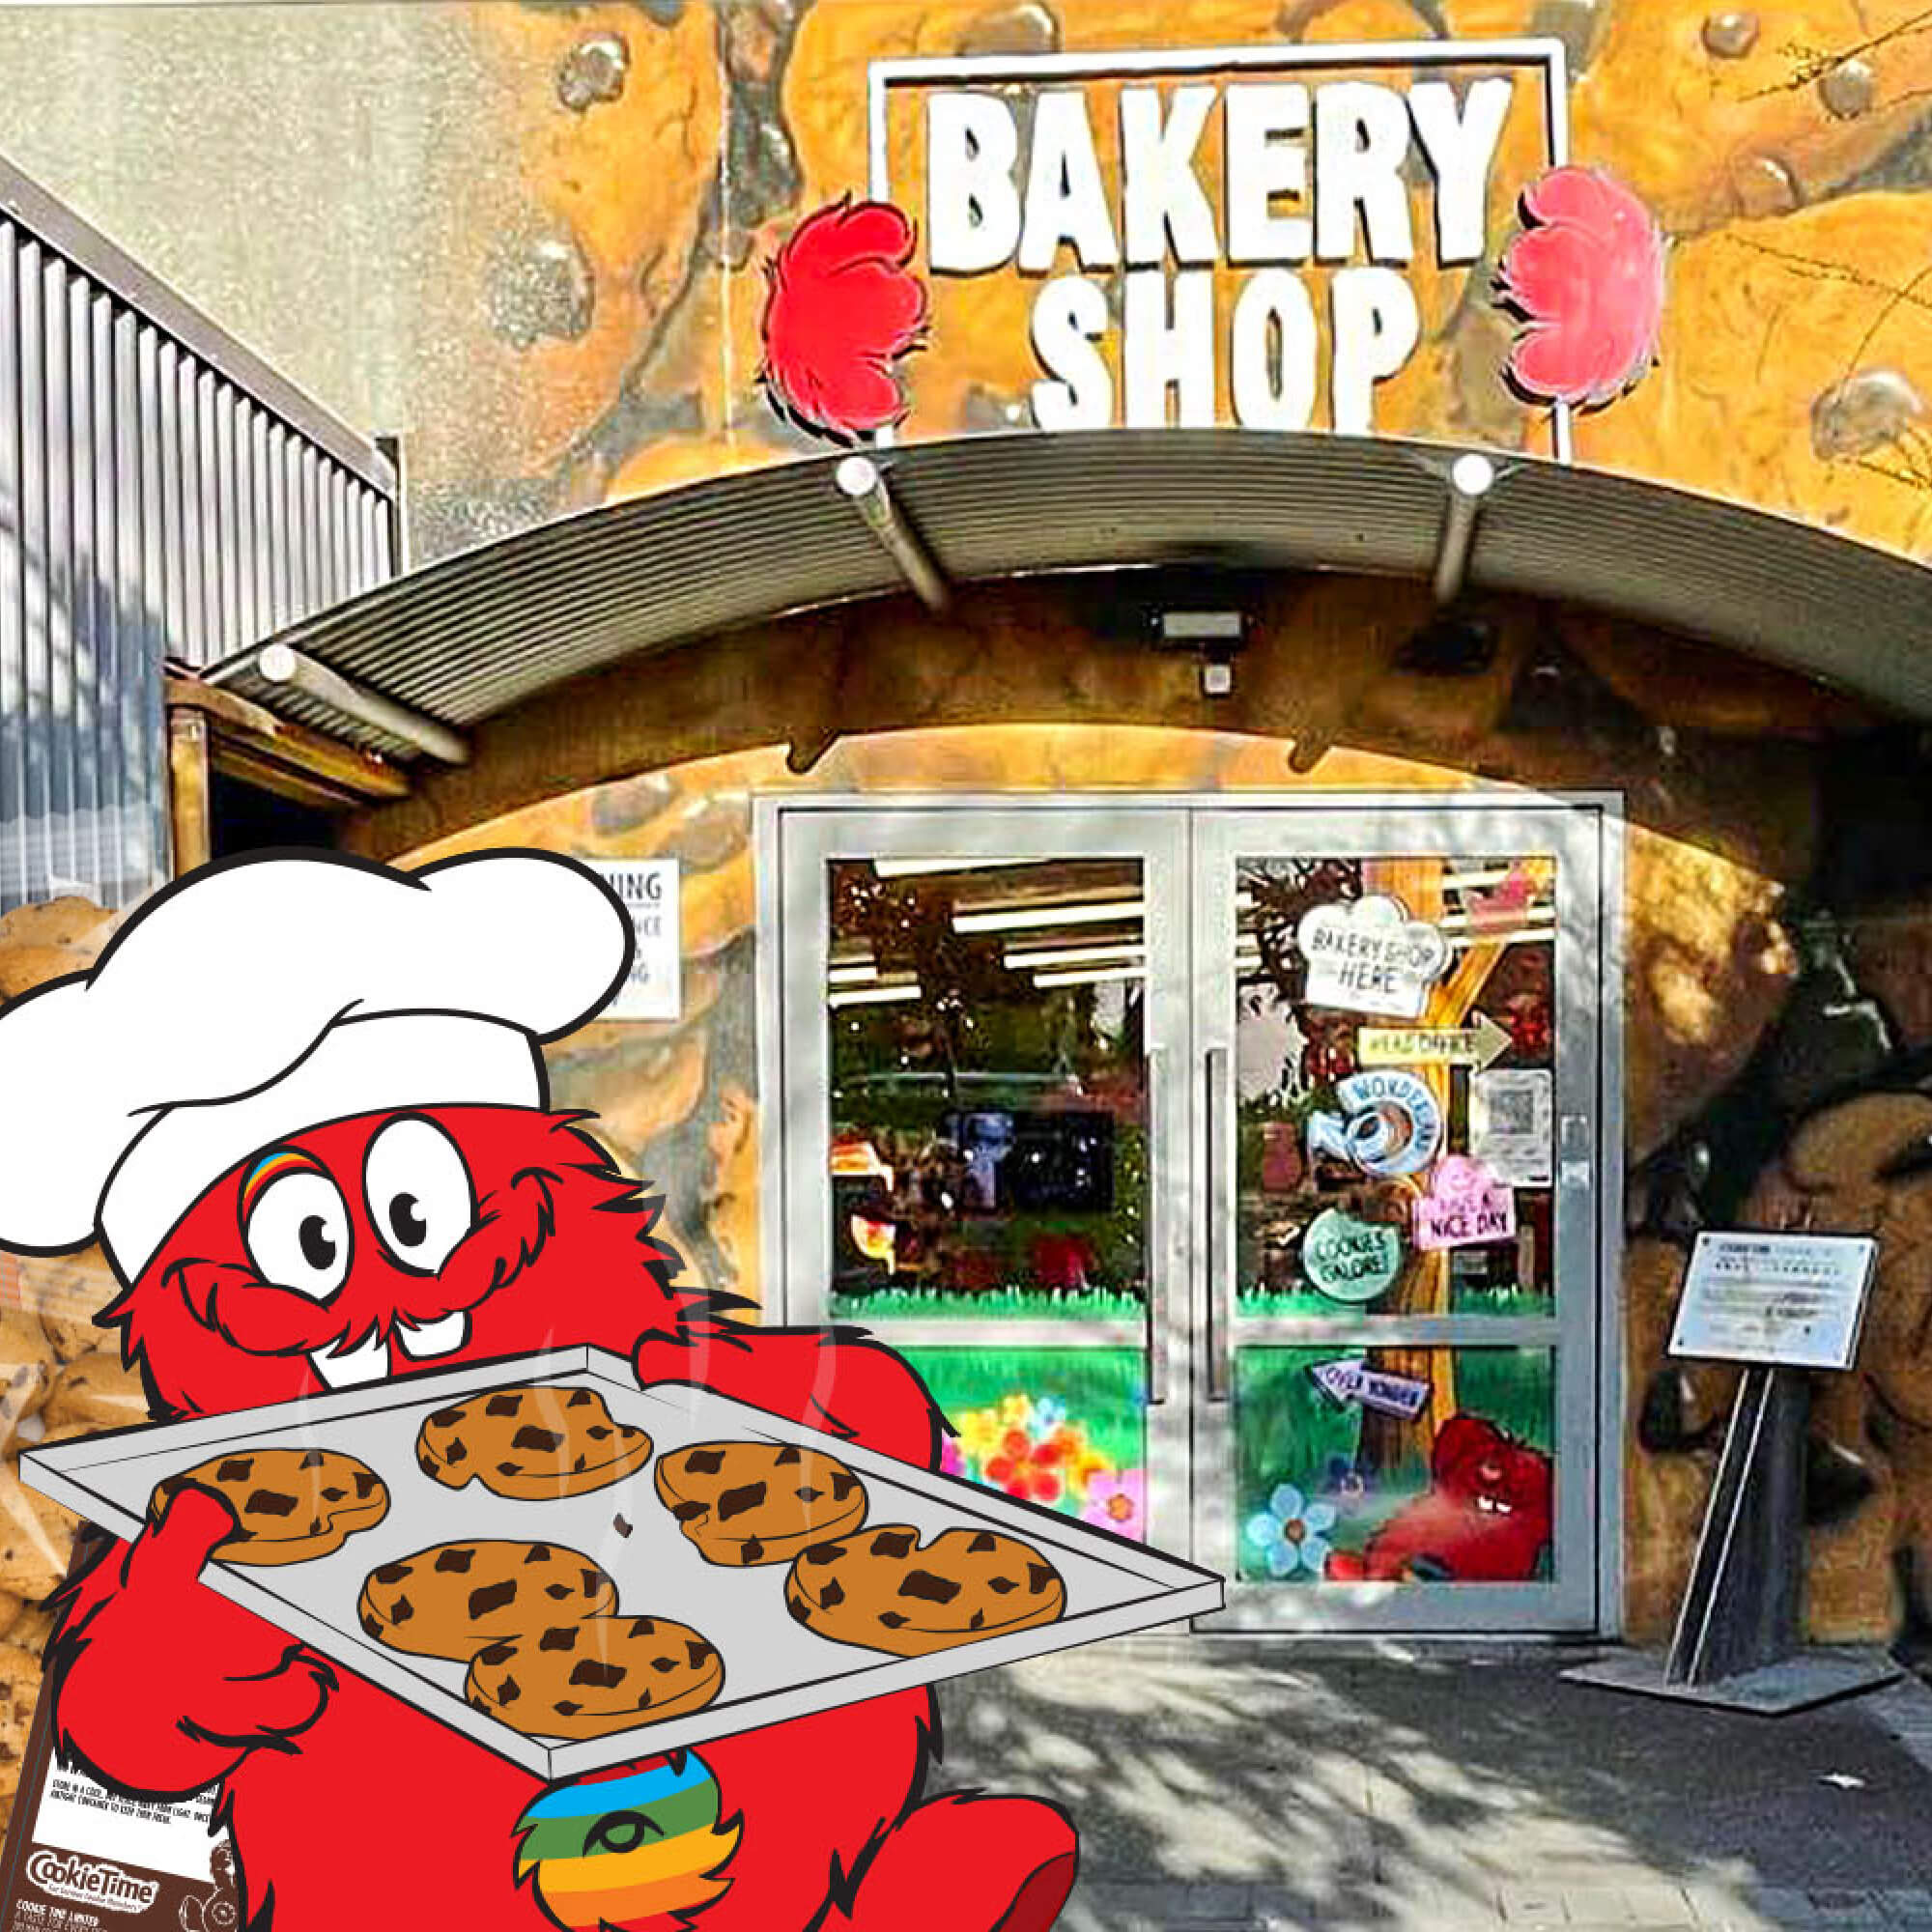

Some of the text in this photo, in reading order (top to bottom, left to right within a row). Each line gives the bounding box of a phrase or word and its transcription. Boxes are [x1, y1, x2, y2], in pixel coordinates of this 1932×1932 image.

[928, 79, 1513, 274] BAKERY
[1032, 267, 1419, 433] SHOP
[1312, 927, 1435, 967] BAKERY SHOP
[1339, 961, 1400, 994] HERE
[1431, 1211, 1508, 1237] NICE DAY
[1315, 1230, 1385, 1262] COOKIES
